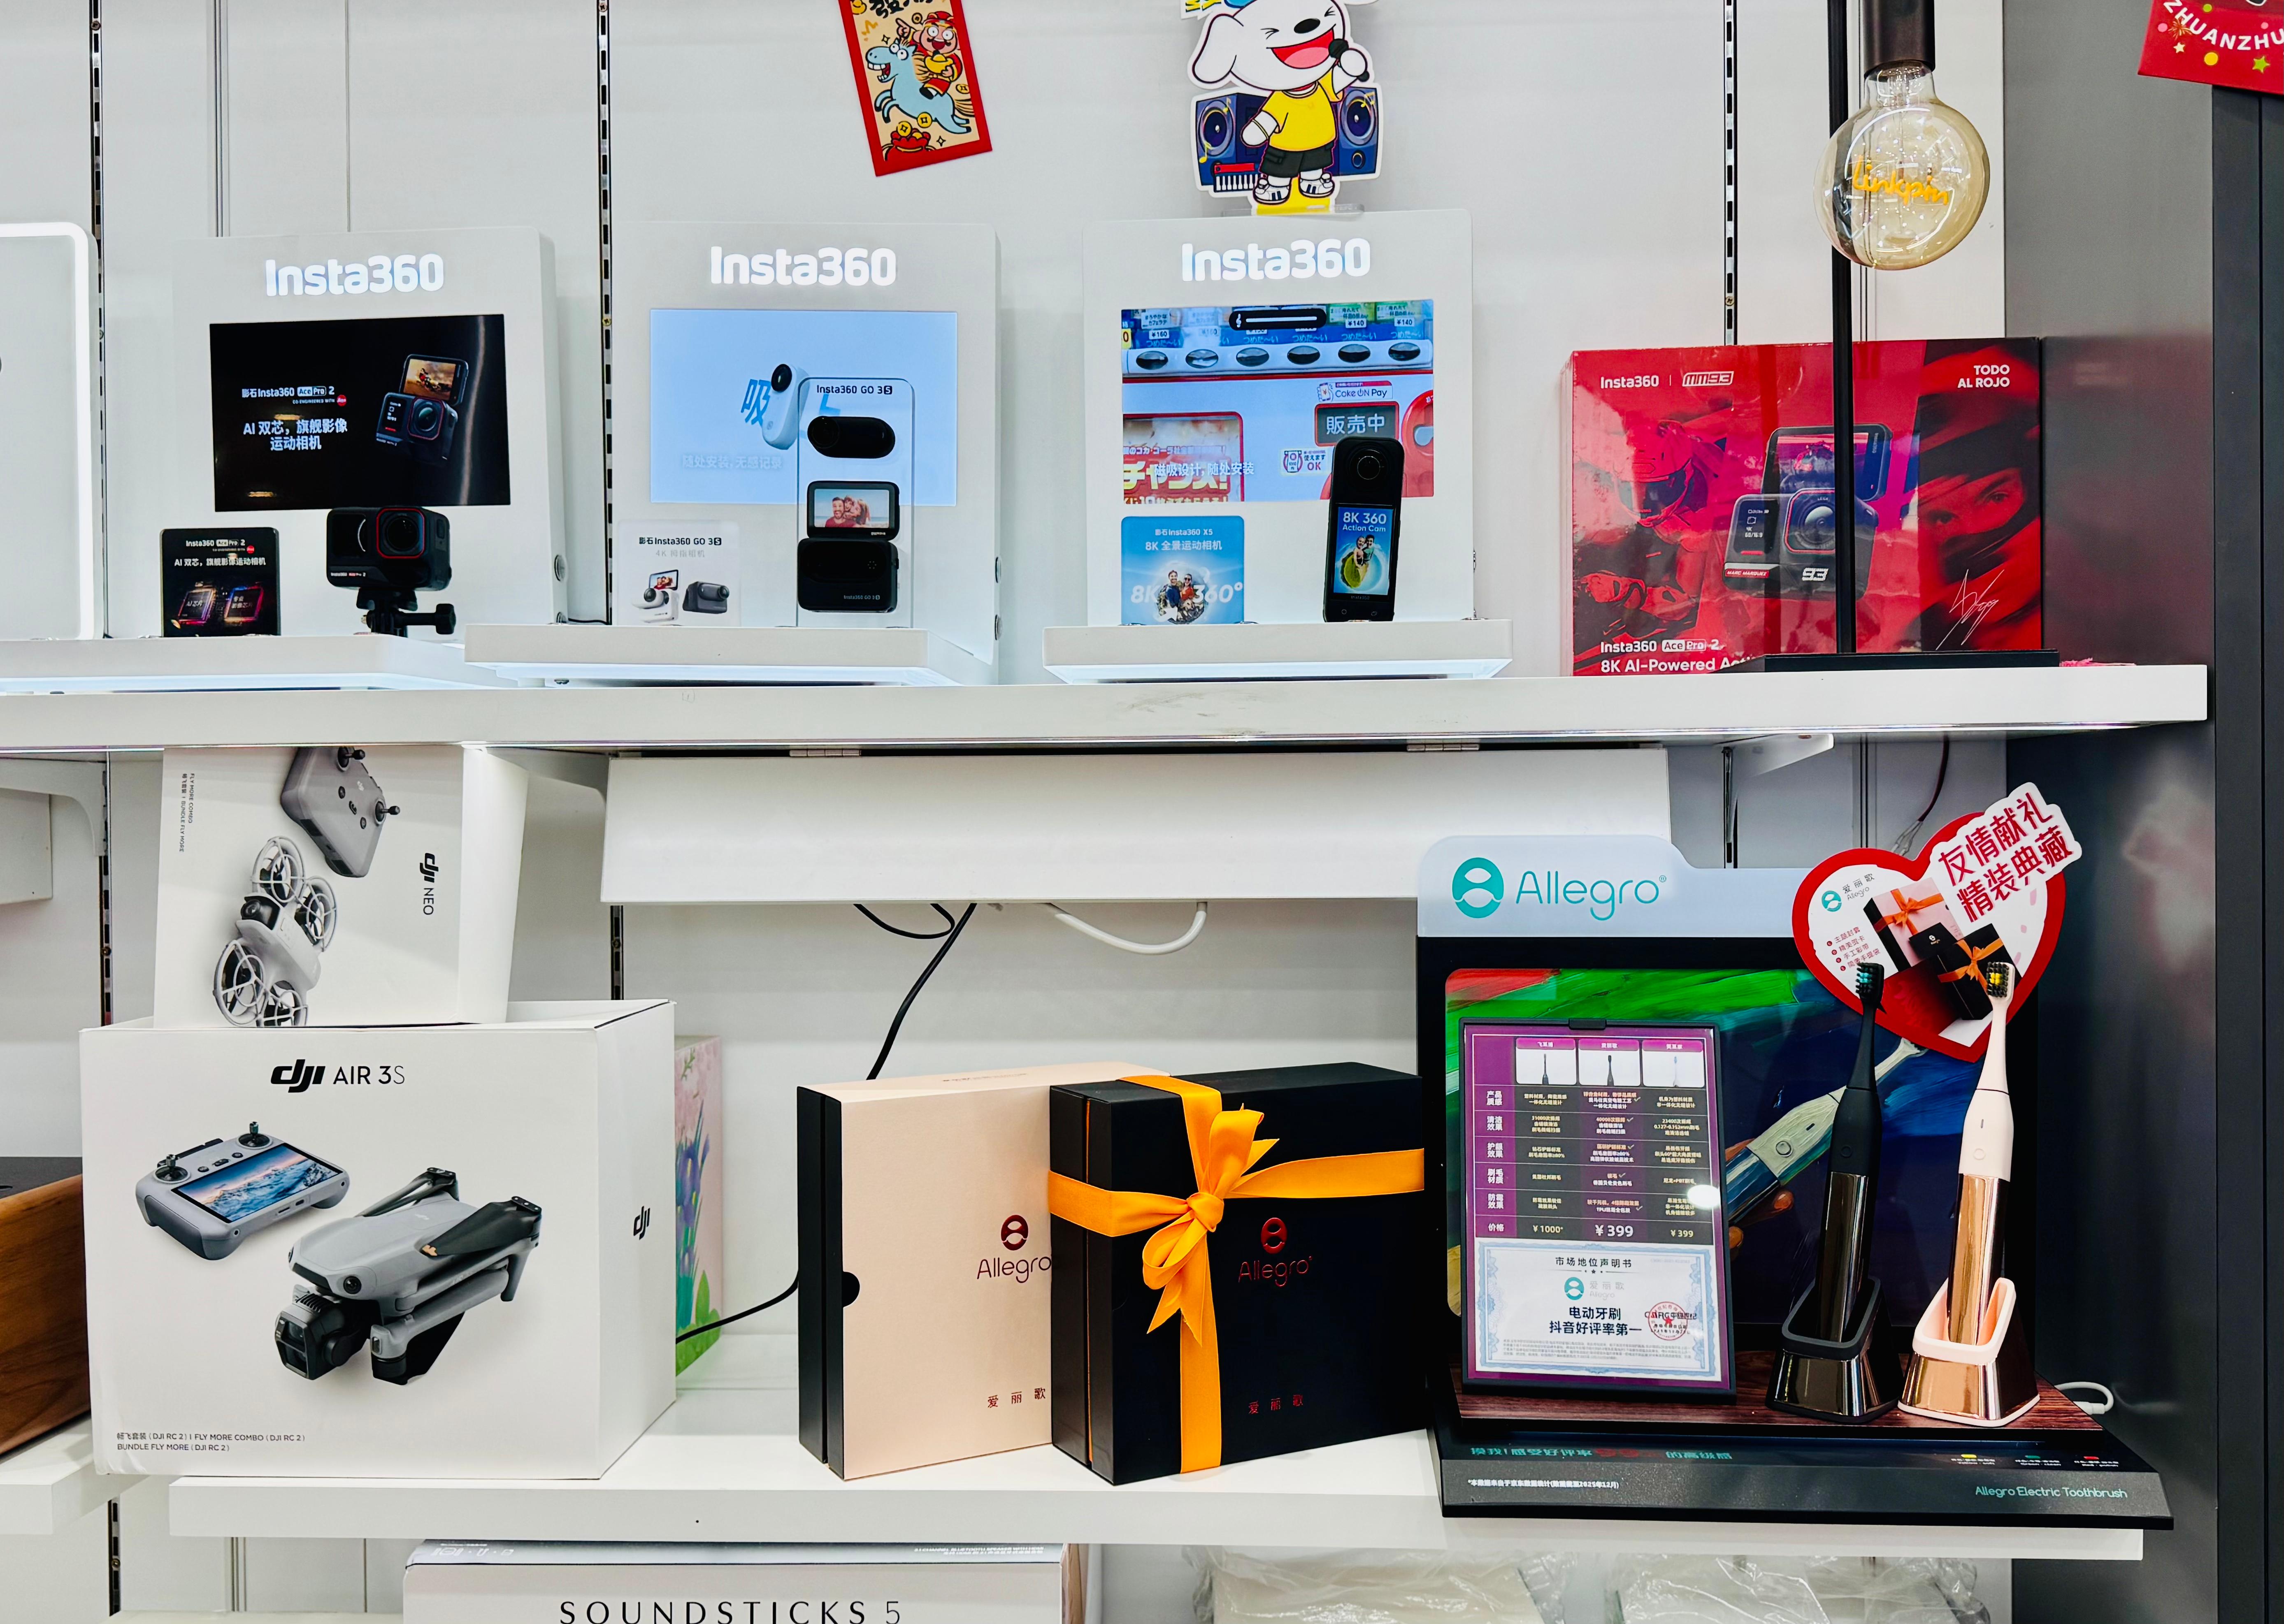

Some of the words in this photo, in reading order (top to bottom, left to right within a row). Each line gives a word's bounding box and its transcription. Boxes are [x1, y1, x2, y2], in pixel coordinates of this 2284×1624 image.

[710, 246, 897, 286] Insta360
[1182, 238, 1371, 281] Insta360
[265, 253, 444, 297] Insta360
[1973, 364, 2010, 375] TODO
[1601, 375, 1659, 389] Insta360
[1957, 378, 1973, 388] AL
[1975, 377, 2010, 387] ROJO
[328, 386, 335, 395] 2
[817, 385, 857, 394] Insta360
[861, 385, 874, 394] GO
[877, 385, 892, 394] 3S
[1371, 389, 1387, 398] Pay
[243, 422, 256, 435] AI
[1326, 413, 1385, 435] 販売中
[270, 435, 322, 451] 运动相机
[1307, 462, 1321, 471] OK
[1343, 512, 1359, 524] 8K
[1363, 513, 1387, 524] 360
[639, 537, 690, 545] 影石Insta360
[708, 537, 722, 545] 3S
[1145, 541, 1159, 551] 8K
[1161, 540, 1222, 551] 全景运动相机
[1802, 567, 1829, 581] 93
[1601, 640, 1657, 653] Insta360
[1664, 641, 1683, 650] Ace
[1687, 640, 1703, 650] Pro
[1711, 639, 1719, 650] 2
[1601, 659, 1621, 673] 8K
[1625, 657, 1716, 673] AI-Powered
[1938, 792, 2053, 886] 友情献礼
[1956, 824, 2074, 923] 精装典藏
[1843, 873, 1875, 894] 爱丽歌
[423, 888, 434, 916] NEO
[333, 1066, 371, 1084] AIR
[378, 1065, 405, 1084] 3S
[1487, 1090, 1502, 1099] 产品
[1487, 1168, 1503, 1176] 刷毛
[1488, 1223, 1504, 1232] 价格
[977, 1256, 1052, 1283] Allegro
[1555, 1257, 1632, 1268] 市场地位声明书
[1590, 1281, 1624, 1290] 爱丽歌
[1569, 1306, 1621, 1320] 电动牙刷
[1549, 1320, 1642, 1336] 抖音好评率第一
[987, 1387, 1046, 1408] 爱丽歌
[1975, 1486, 2015, 1498] Allegro
[2016, 1486, 2061, 1497] Electric
[2062, 1487, 2128, 1498] Toothbrush
[560, 1601, 866, 1624] SOUNDSTICKS
[886, 1601, 900, 1624] 5
